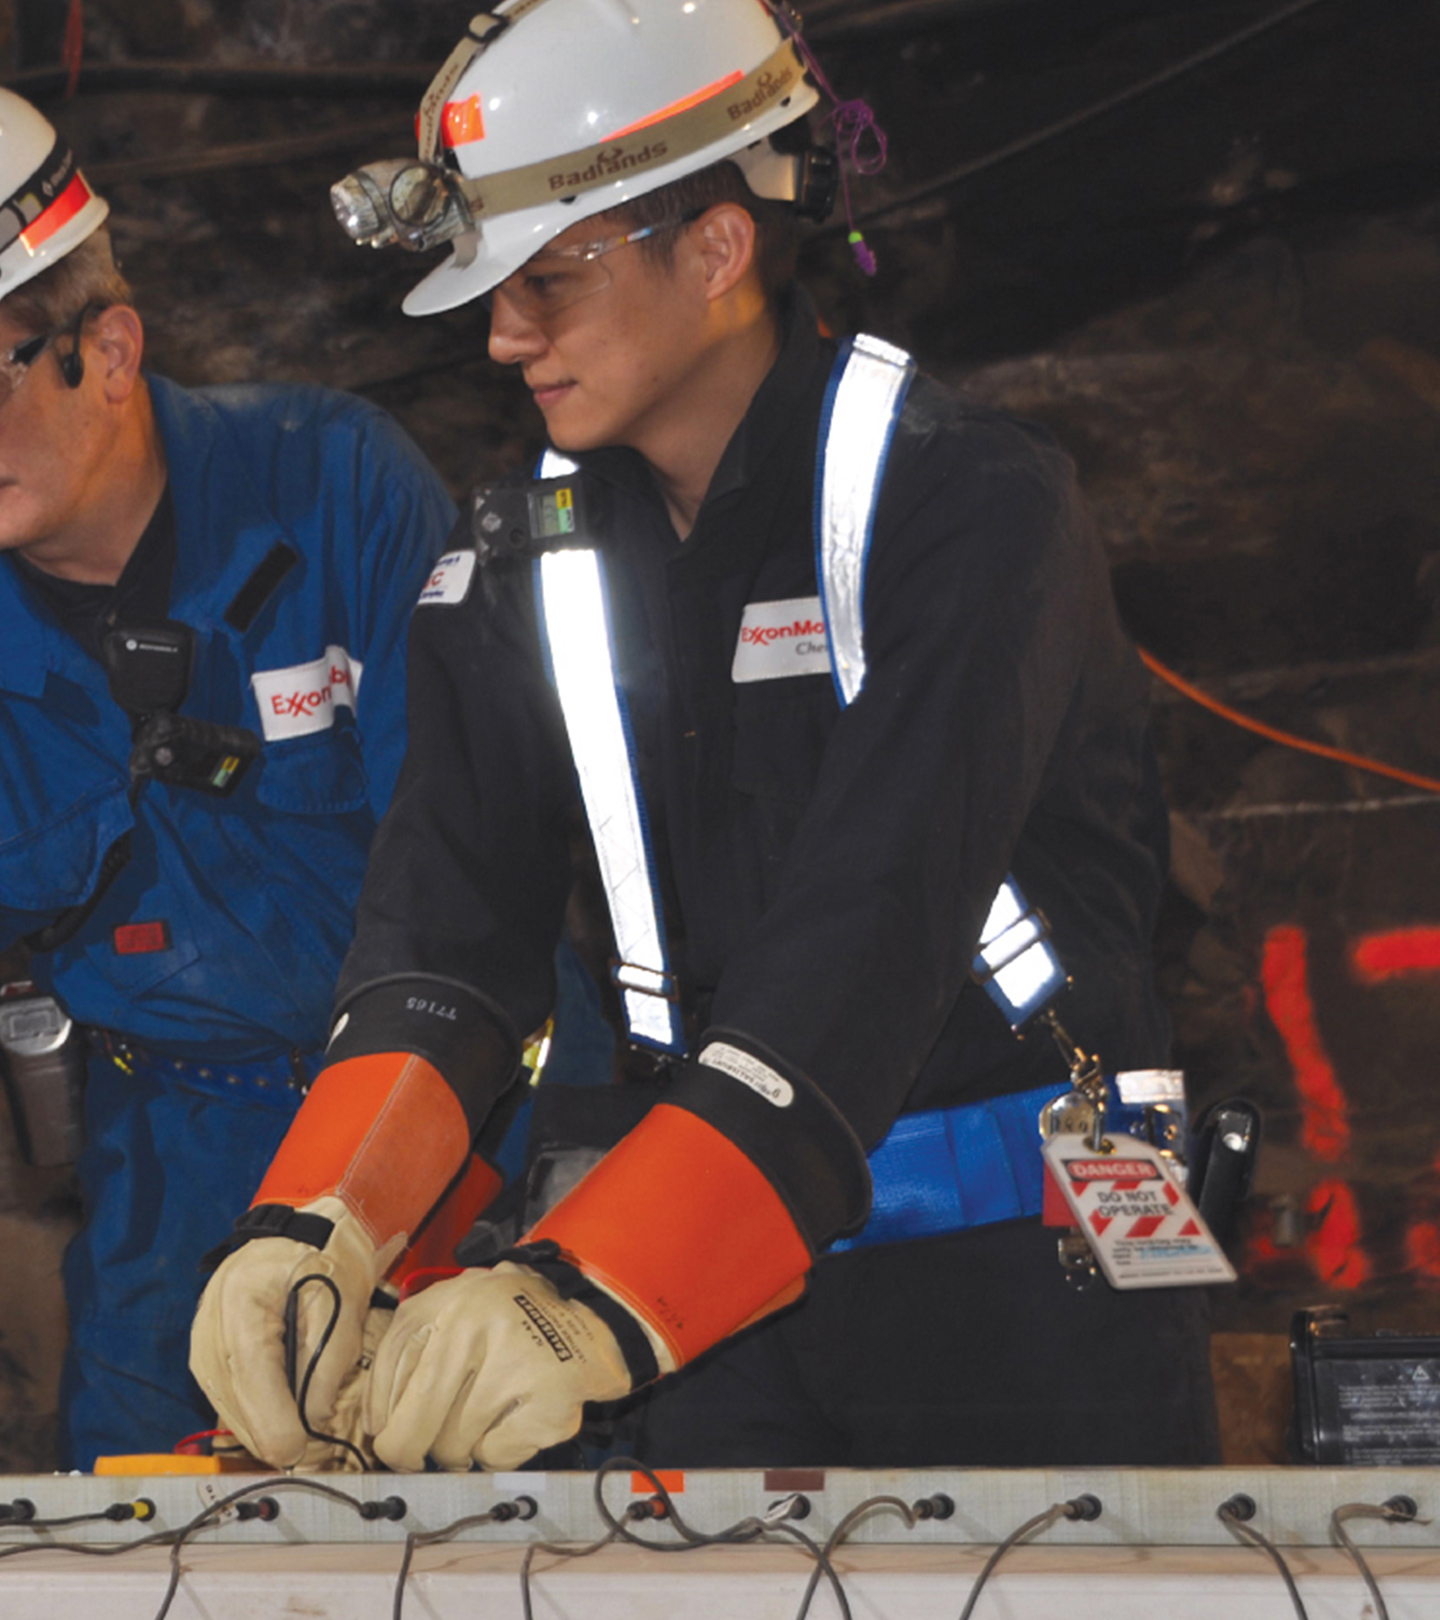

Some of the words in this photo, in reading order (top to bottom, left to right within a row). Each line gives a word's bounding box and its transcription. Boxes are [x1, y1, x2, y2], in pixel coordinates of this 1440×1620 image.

[727, 67, 793, 121] Badlands
[548, 140, 669, 191] Badlands
[1073, 1163, 1153, 1177] DANGER
[1097, 1192, 1121, 1204] DO
[1126, 1191, 1157, 1202] NOT
[1098, 1204, 1173, 1217] OPERATE
